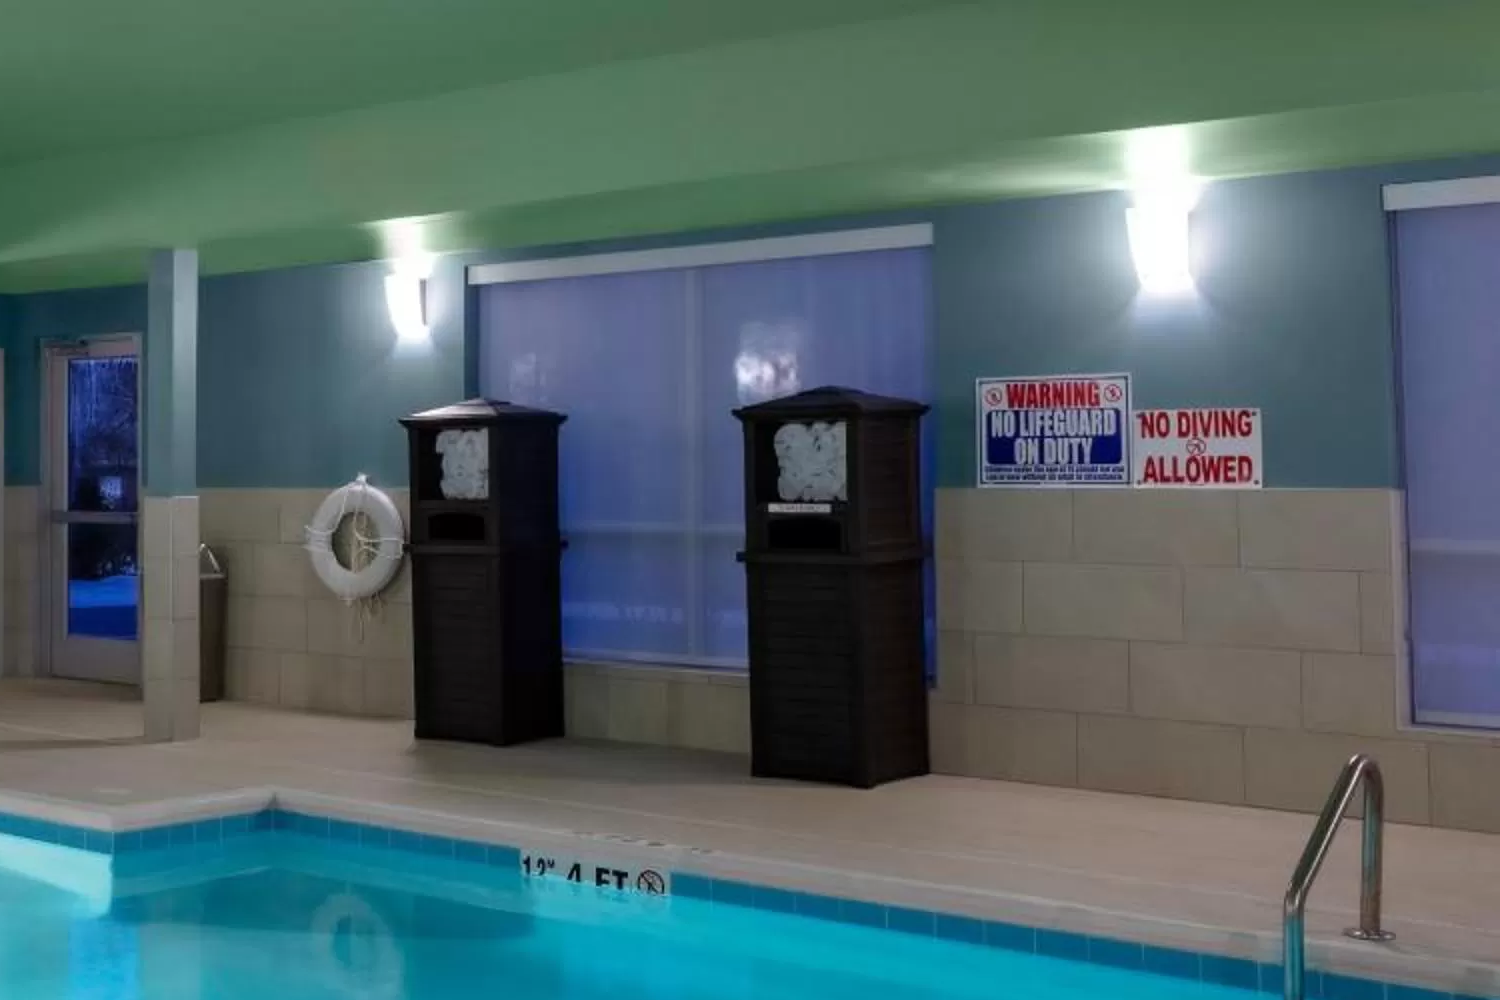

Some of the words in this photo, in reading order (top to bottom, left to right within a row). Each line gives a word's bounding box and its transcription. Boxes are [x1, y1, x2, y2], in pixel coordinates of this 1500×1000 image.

[1006, 382, 1100, 409] WARNING
[991, 409, 1017, 438] NO
[1019, 409, 1117, 437] LIFEGUARD
[1140, 411, 1171, 439] NO
[1176, 409, 1253, 439] DIVING
[1014, 438, 1041, 465] ON
[1043, 437, 1093, 465] DUTY
[1143, 455, 1253, 484] ALLOWED
[595, 866, 629, 891] FT
